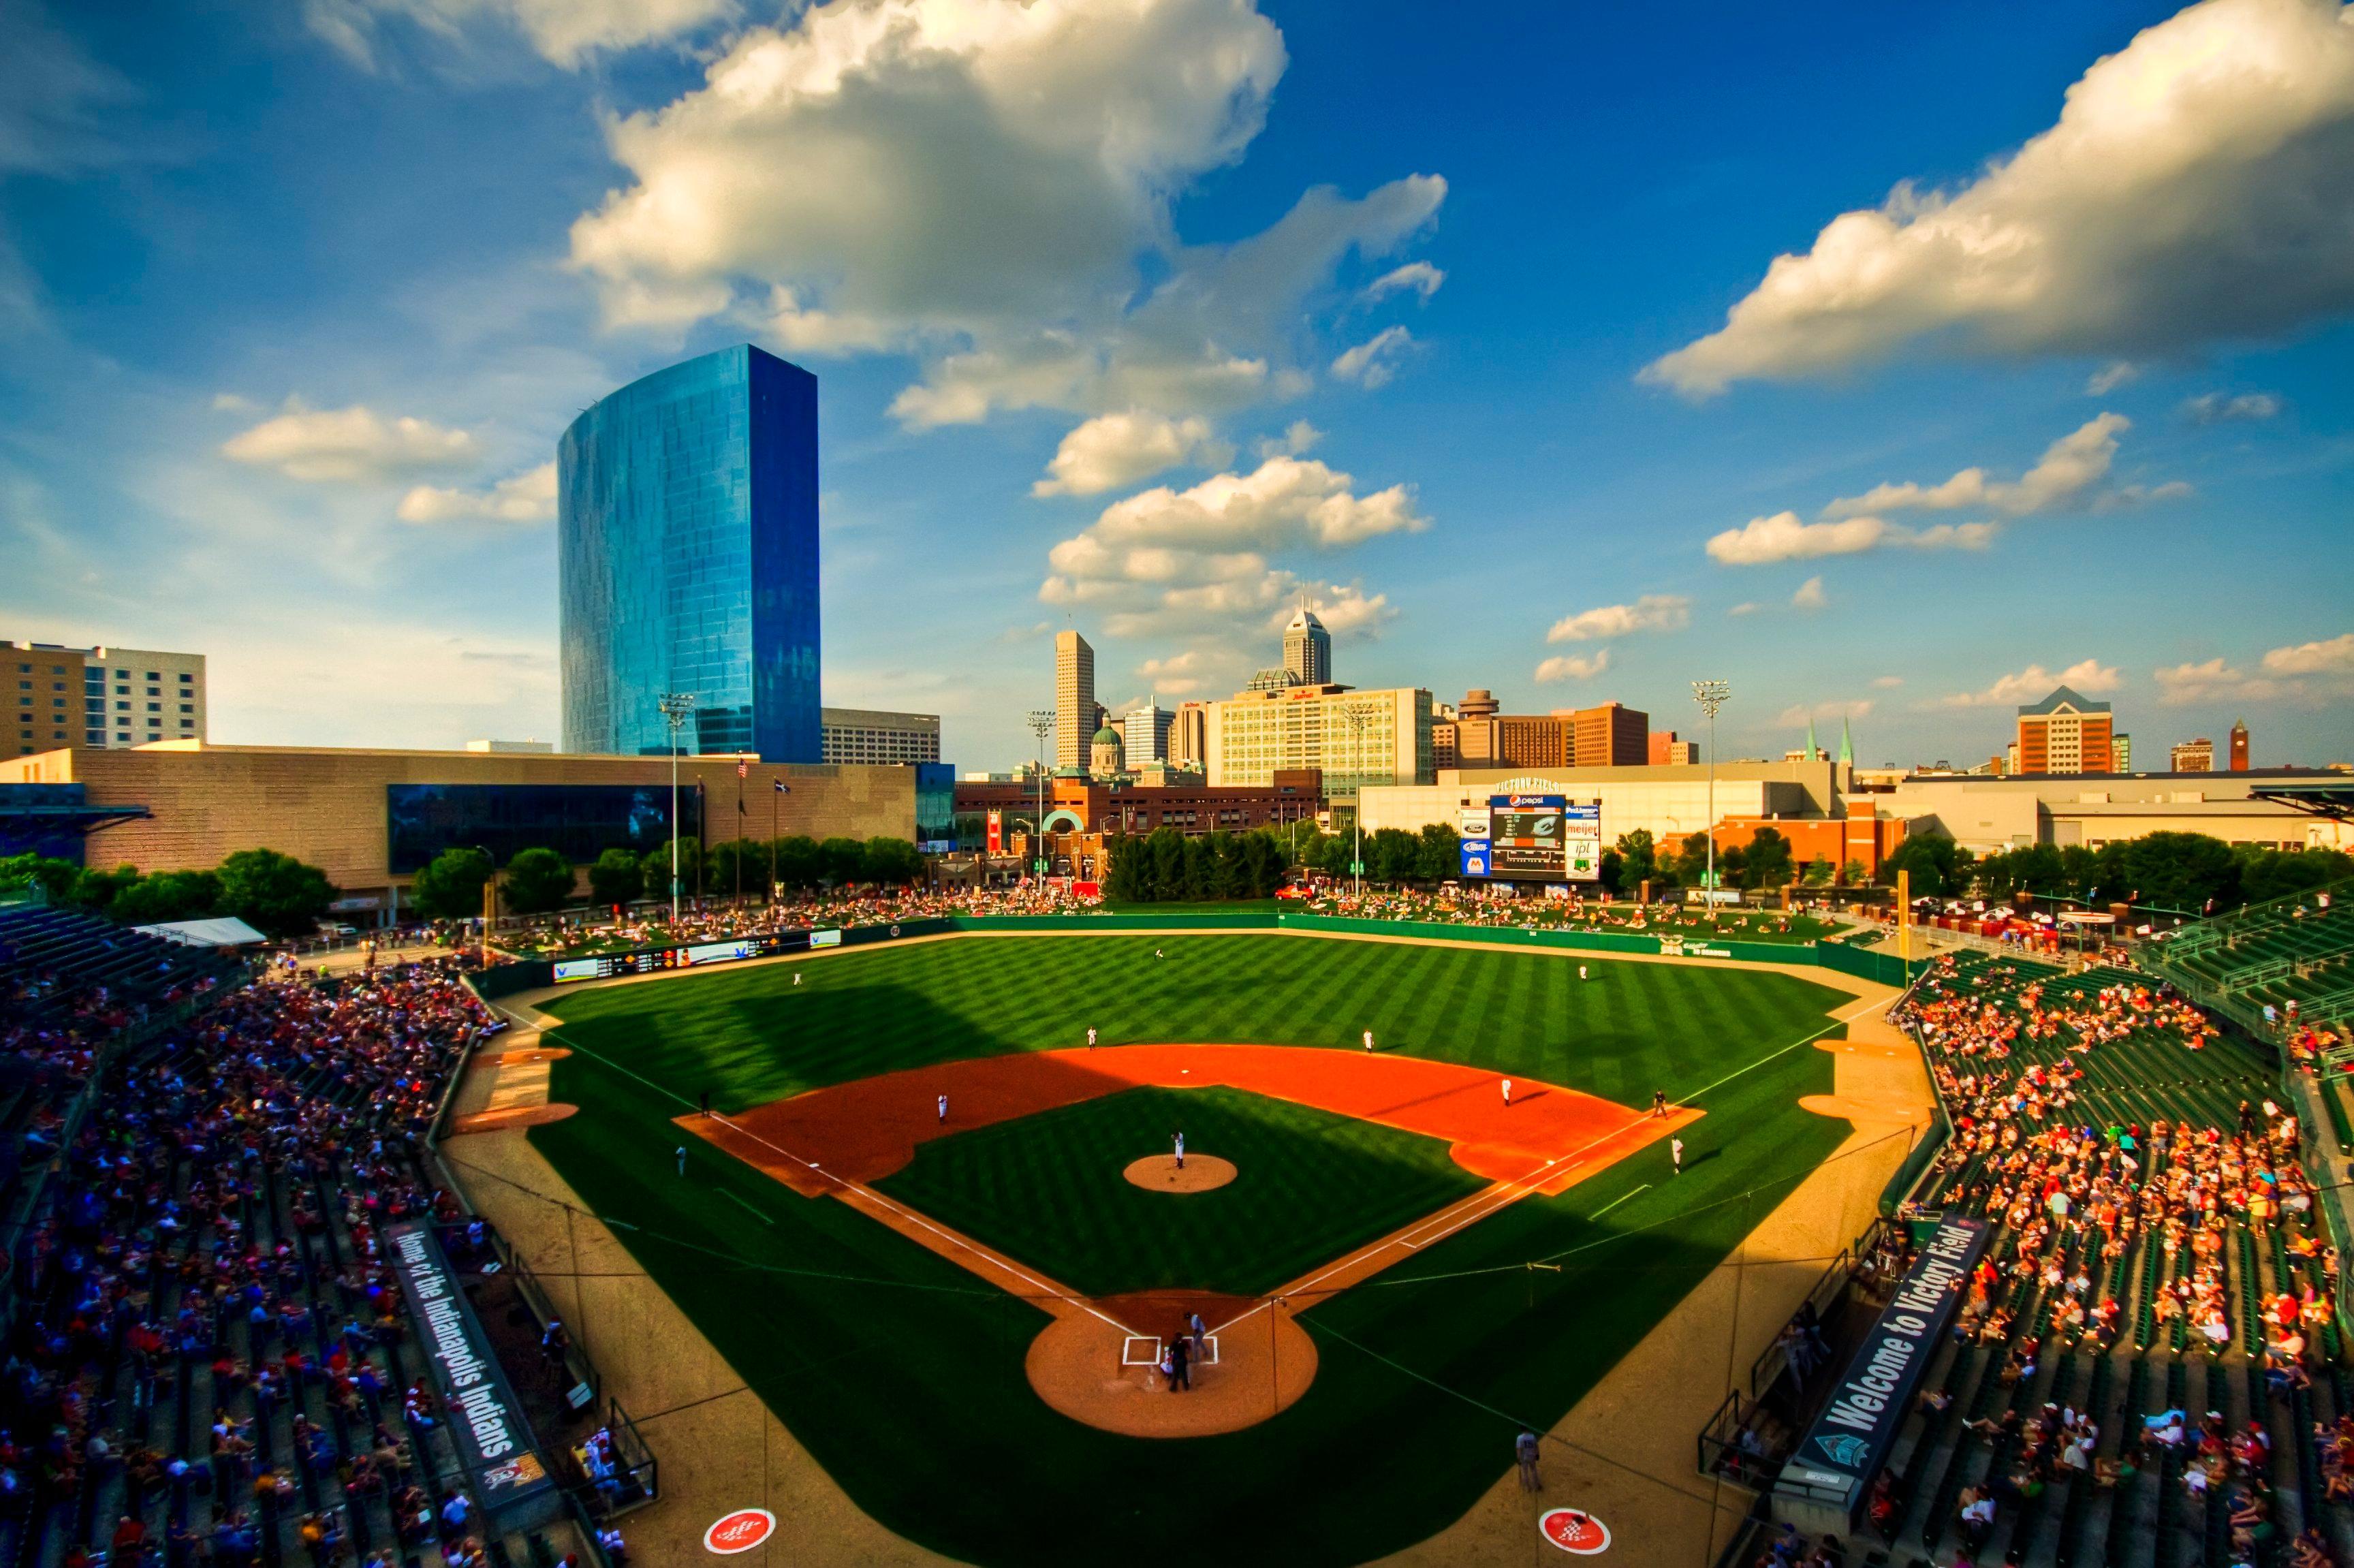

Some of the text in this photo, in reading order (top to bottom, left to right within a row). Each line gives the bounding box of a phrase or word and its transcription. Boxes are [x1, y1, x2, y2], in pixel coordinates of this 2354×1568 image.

[1495, 777, 1560, 793] VICTORY FIELD
[1521, 796, 1543, 805] pepsi
[1567, 823, 1597, 835] meijer
[1575, 842, 1590, 857] ipl
[1825, 1225, 1975, 1431] Welcome to Victory Field
[396, 1231, 513, 1459] Home of the Indianapolis Indians
